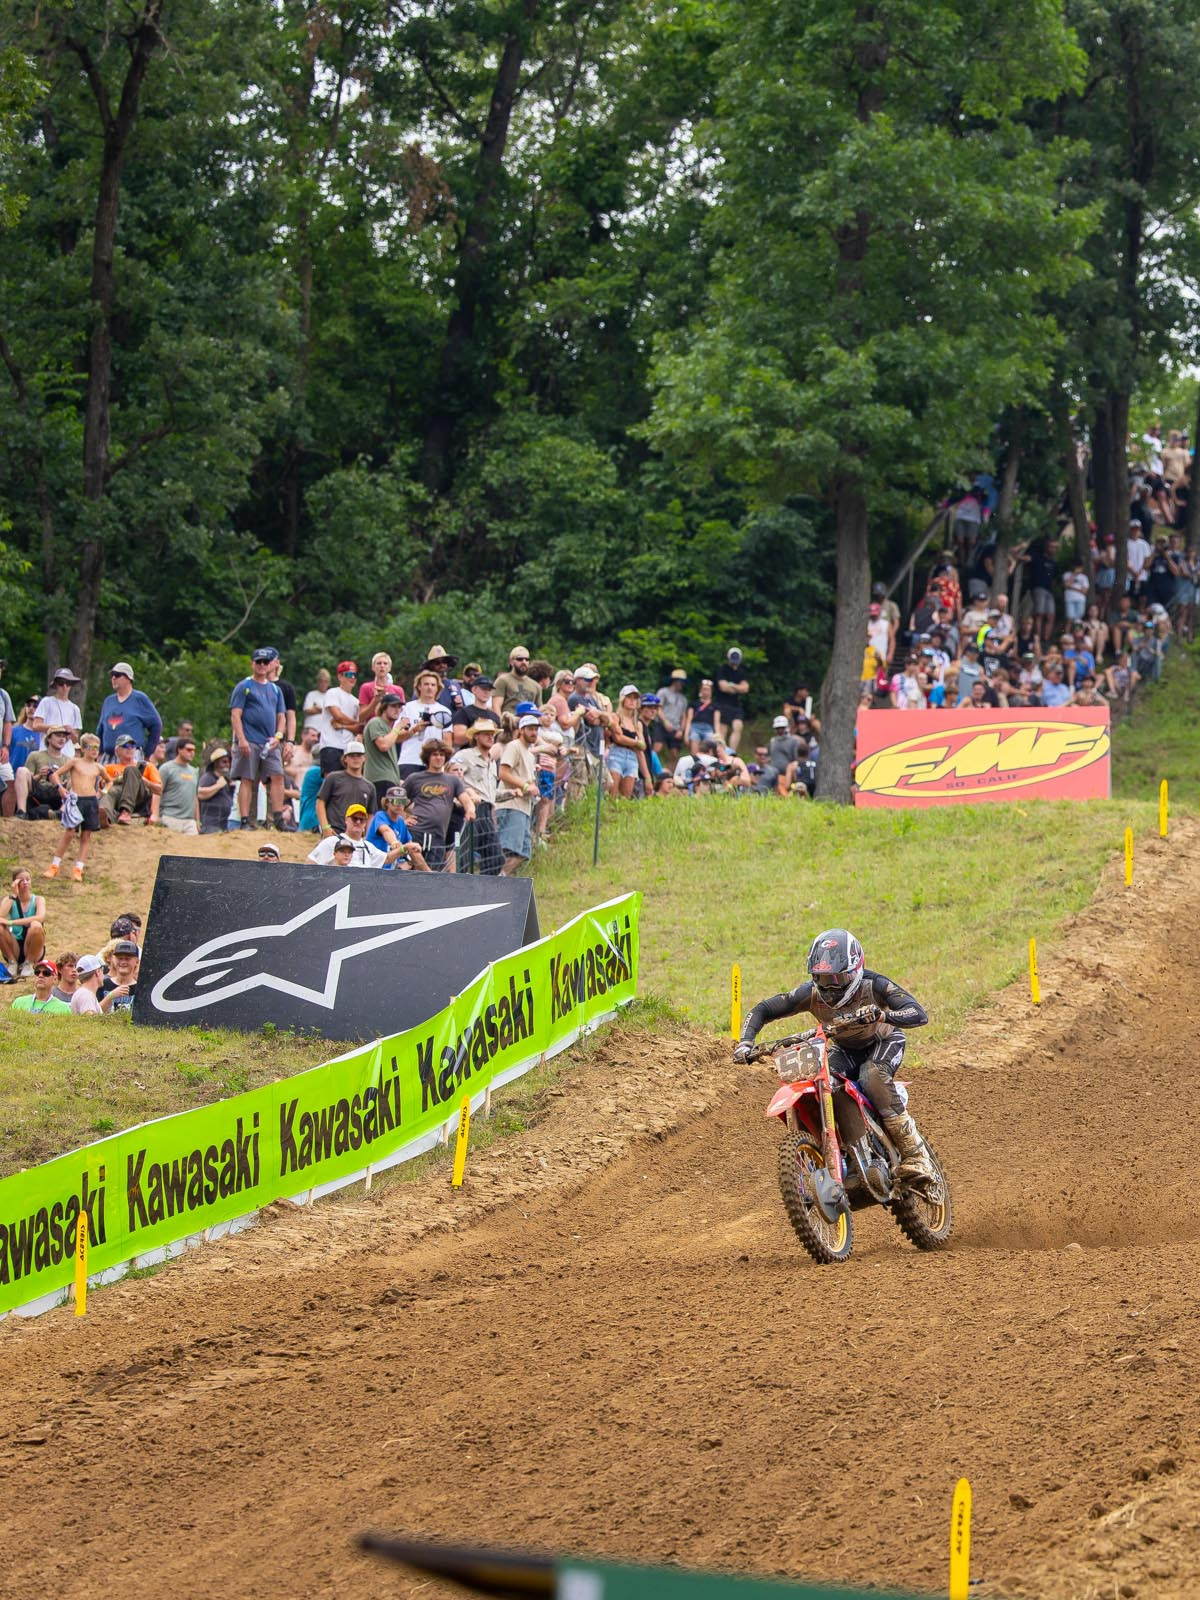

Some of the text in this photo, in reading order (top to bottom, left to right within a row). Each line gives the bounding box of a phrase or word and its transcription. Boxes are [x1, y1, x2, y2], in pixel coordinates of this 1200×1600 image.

[858, 724, 1107, 792] FMF
[550, 916, 632, 1025] Kawasaki
[416, 968, 535, 1113] Kawasaki
[127, 1112, 260, 1233] Kawasaki
[279, 1058, 402, 1177] Kawasaki
[460, 1105, 468, 1138] ACERBIS
[0, 1165, 107, 1285] awasaki
[79, 1224, 87, 1262] ACERBIS
